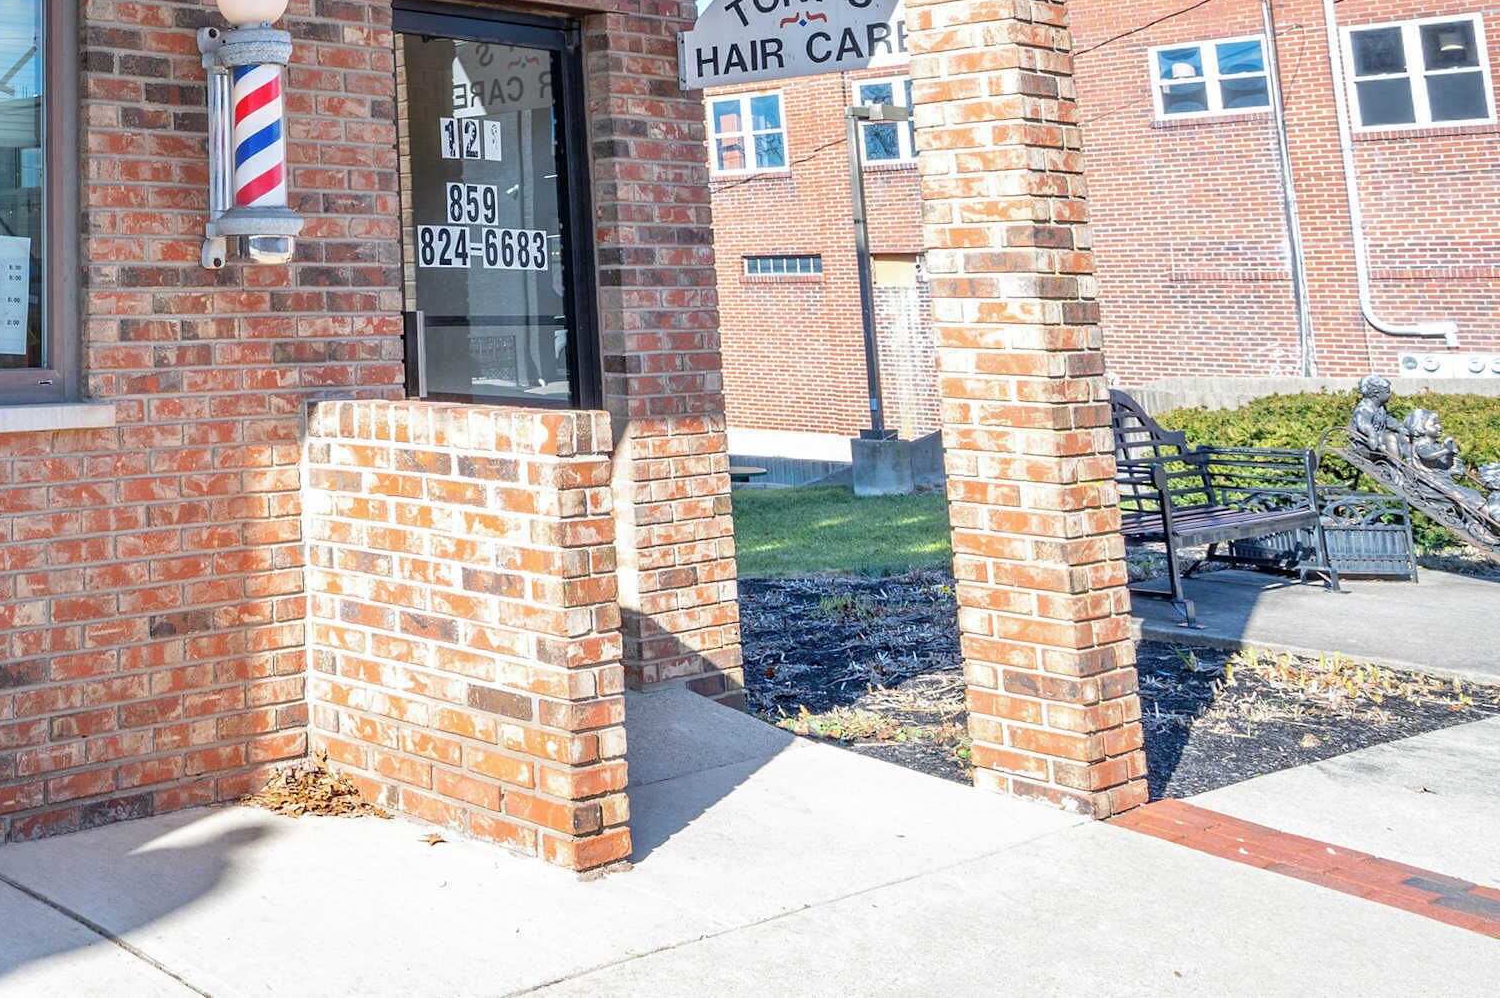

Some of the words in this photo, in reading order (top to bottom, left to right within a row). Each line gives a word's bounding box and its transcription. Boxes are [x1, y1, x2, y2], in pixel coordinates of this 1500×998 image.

[695, 37, 785, 78] HAIR
[449, 184, 497, 224] 859
[421, 228, 546, 269] 824-6683
